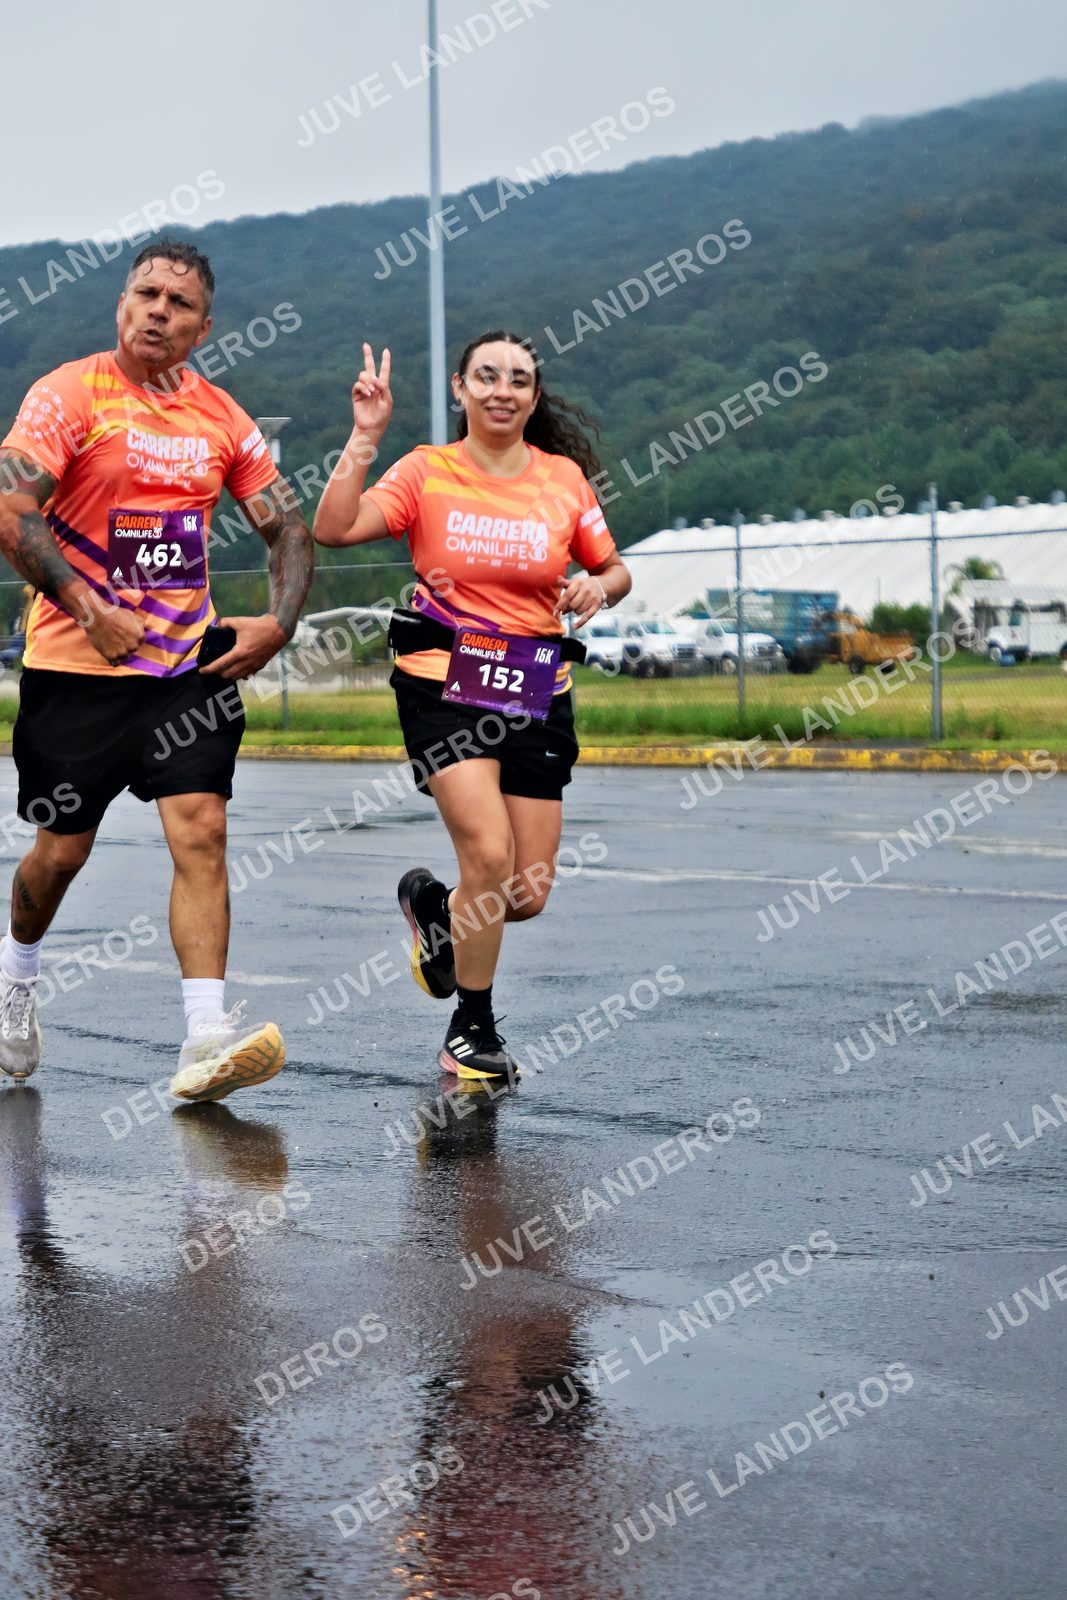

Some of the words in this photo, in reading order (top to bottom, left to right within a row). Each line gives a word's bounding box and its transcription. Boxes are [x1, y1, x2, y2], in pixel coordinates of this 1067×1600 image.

[126, 427, 210, 460] CARRERA
[115, 515, 163, 528] CARRERA
[446, 510, 549, 542] CARRERA
[136, 543, 182, 567] 462
[461, 632, 508, 652] CARRERA
[479, 663, 525, 693] 152
